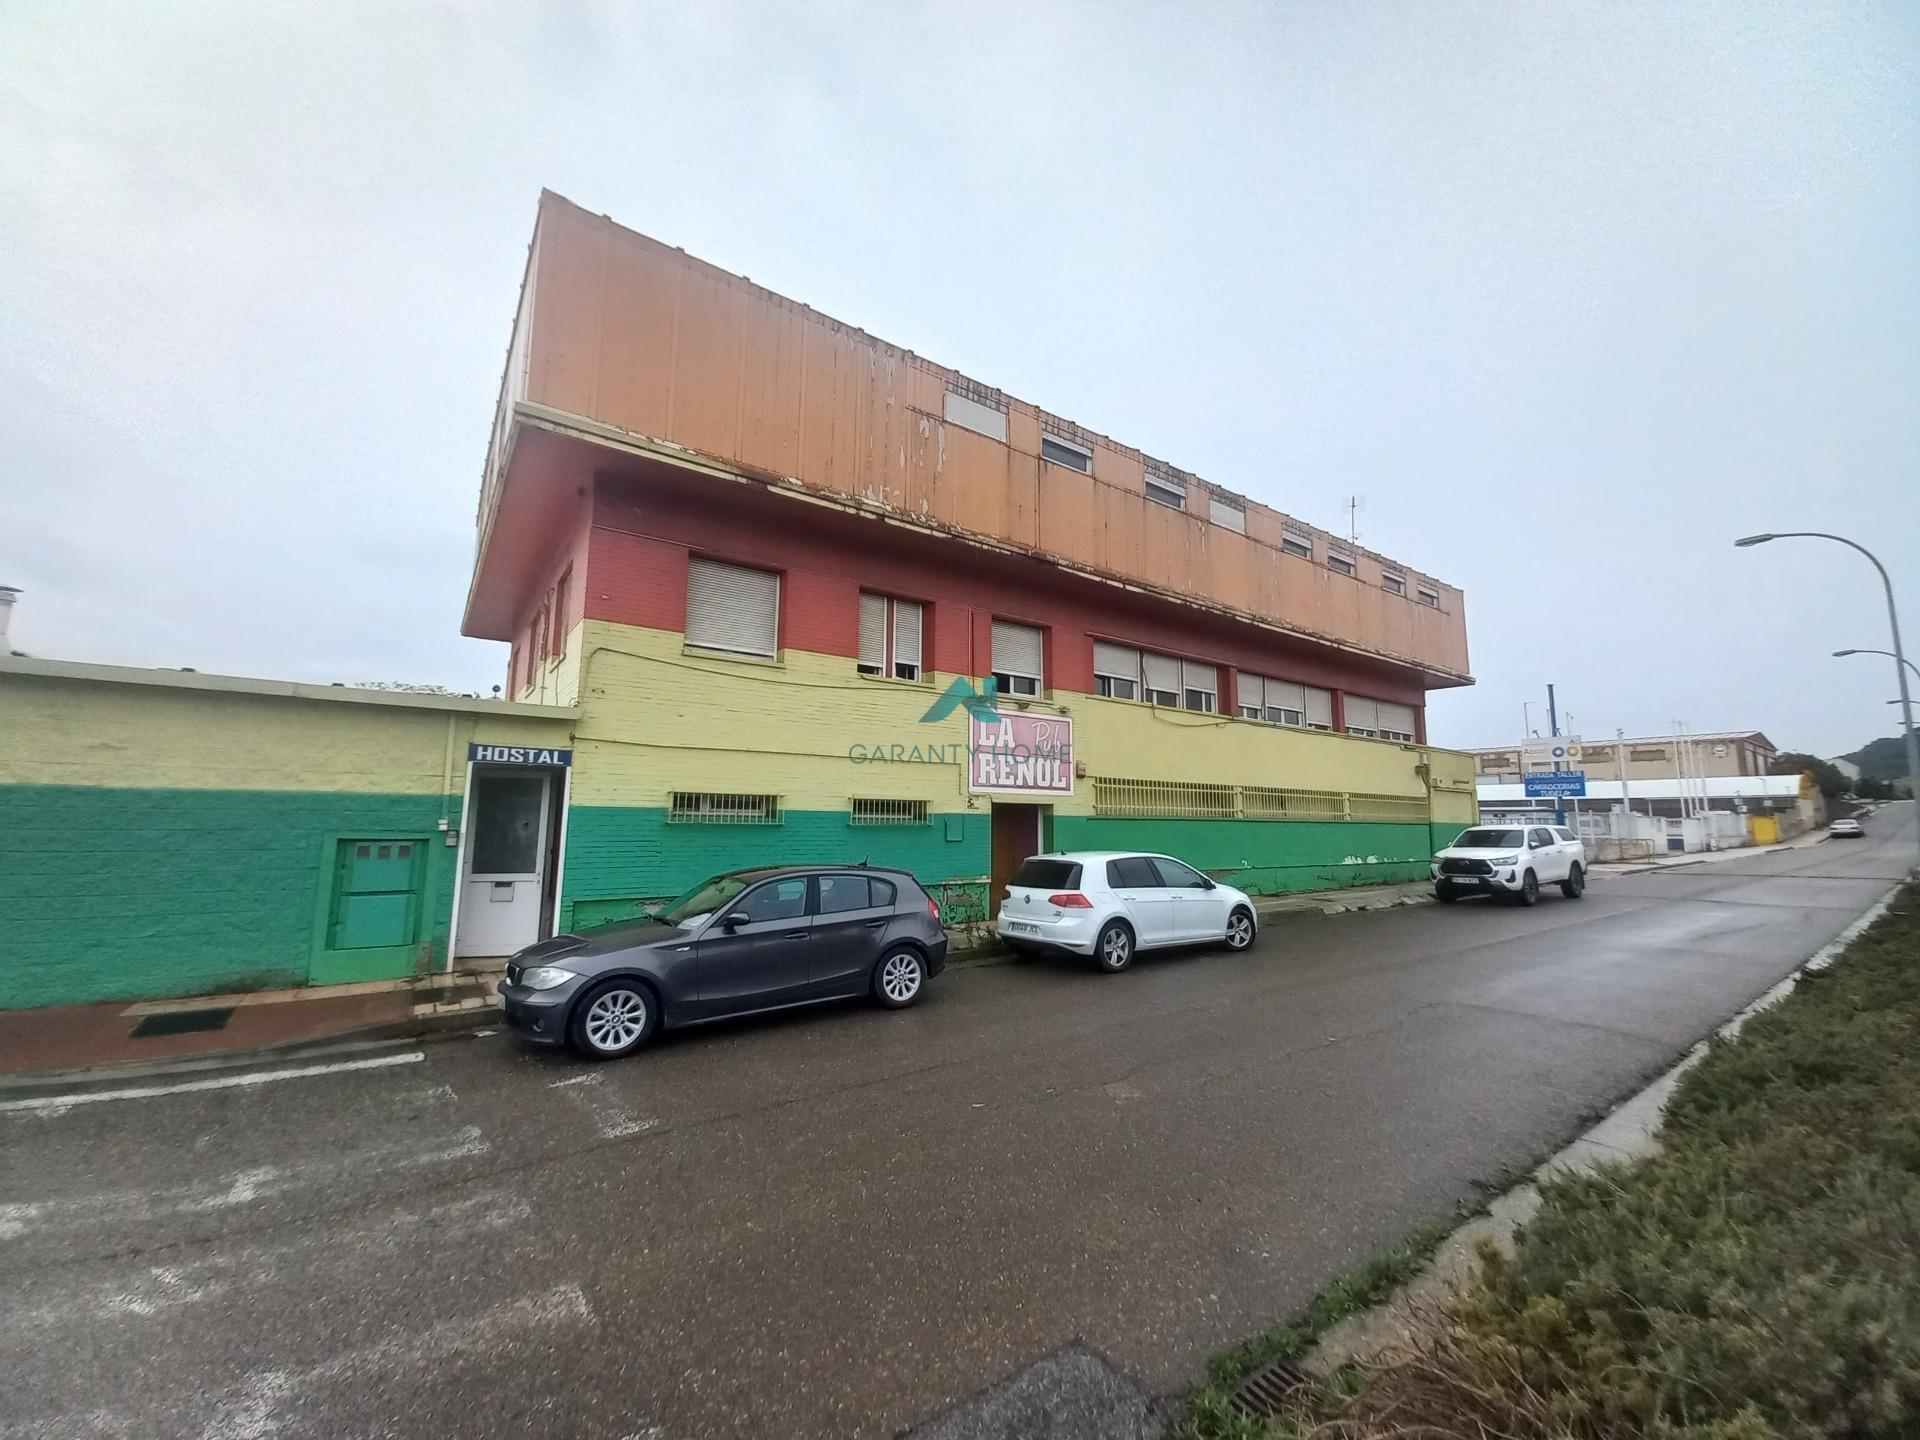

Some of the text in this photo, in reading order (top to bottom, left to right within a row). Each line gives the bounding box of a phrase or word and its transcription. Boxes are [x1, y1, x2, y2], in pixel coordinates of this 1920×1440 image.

[978, 717, 1015, 748] LA
[1031, 720, 1061, 753] Pub
[476, 746, 564, 765] HOSTAL
[977, 752, 1067, 788] RENOL
